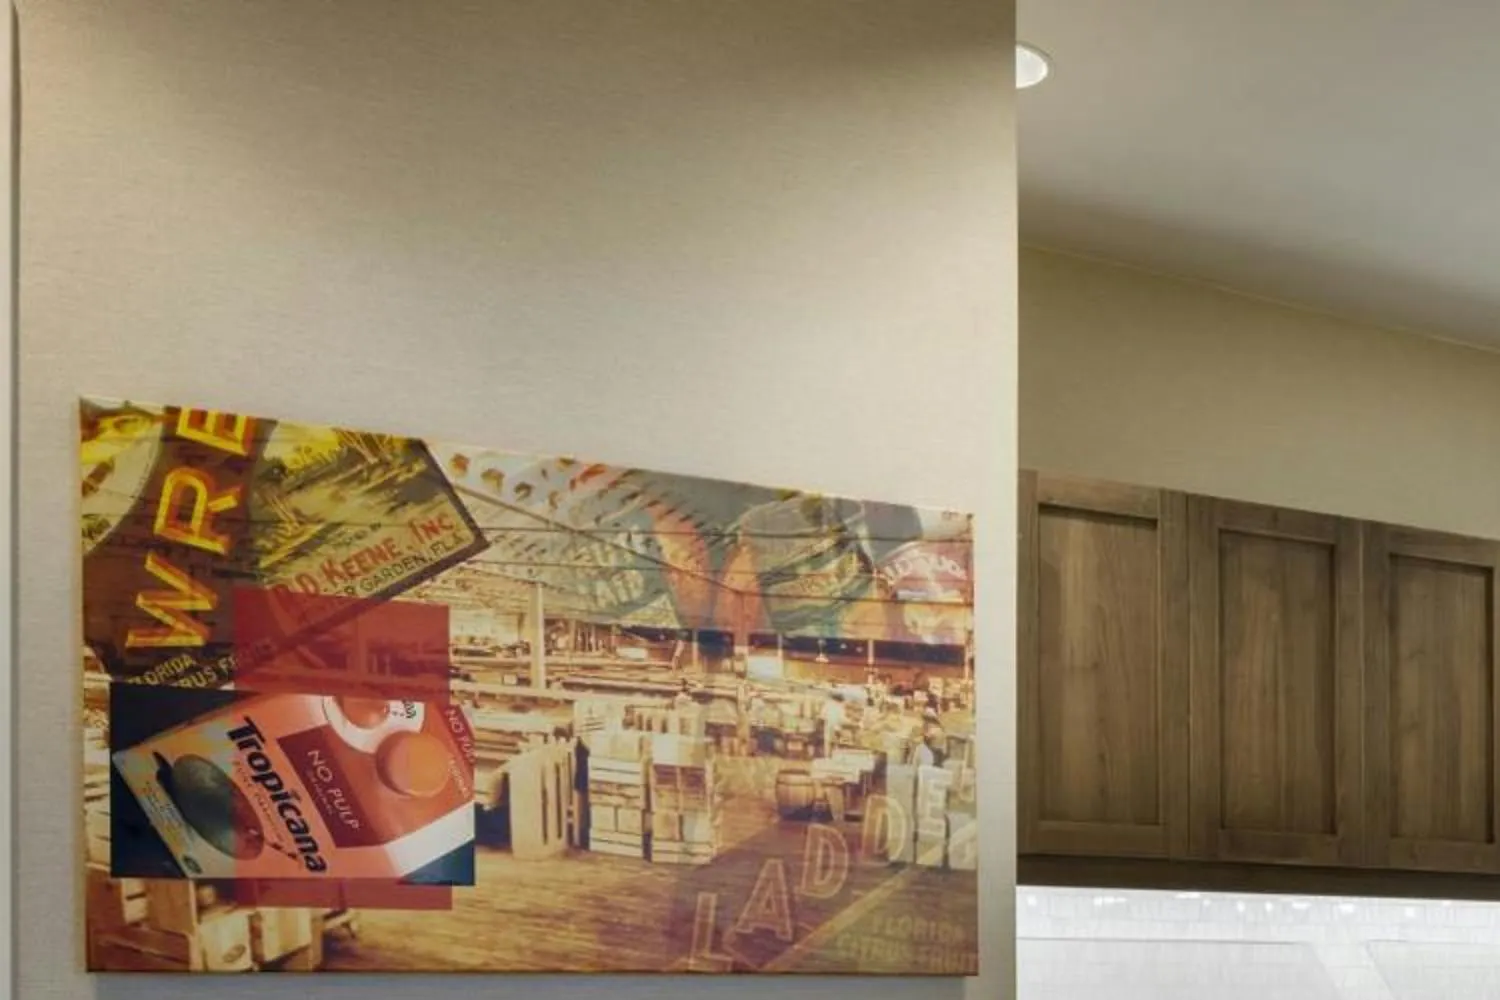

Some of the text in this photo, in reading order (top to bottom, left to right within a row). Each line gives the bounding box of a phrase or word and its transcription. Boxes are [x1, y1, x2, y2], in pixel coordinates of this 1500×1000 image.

[227, 715, 328, 874] Tropicana
[307, 750, 333, 783] NO
[326, 787, 360, 831] PULP
